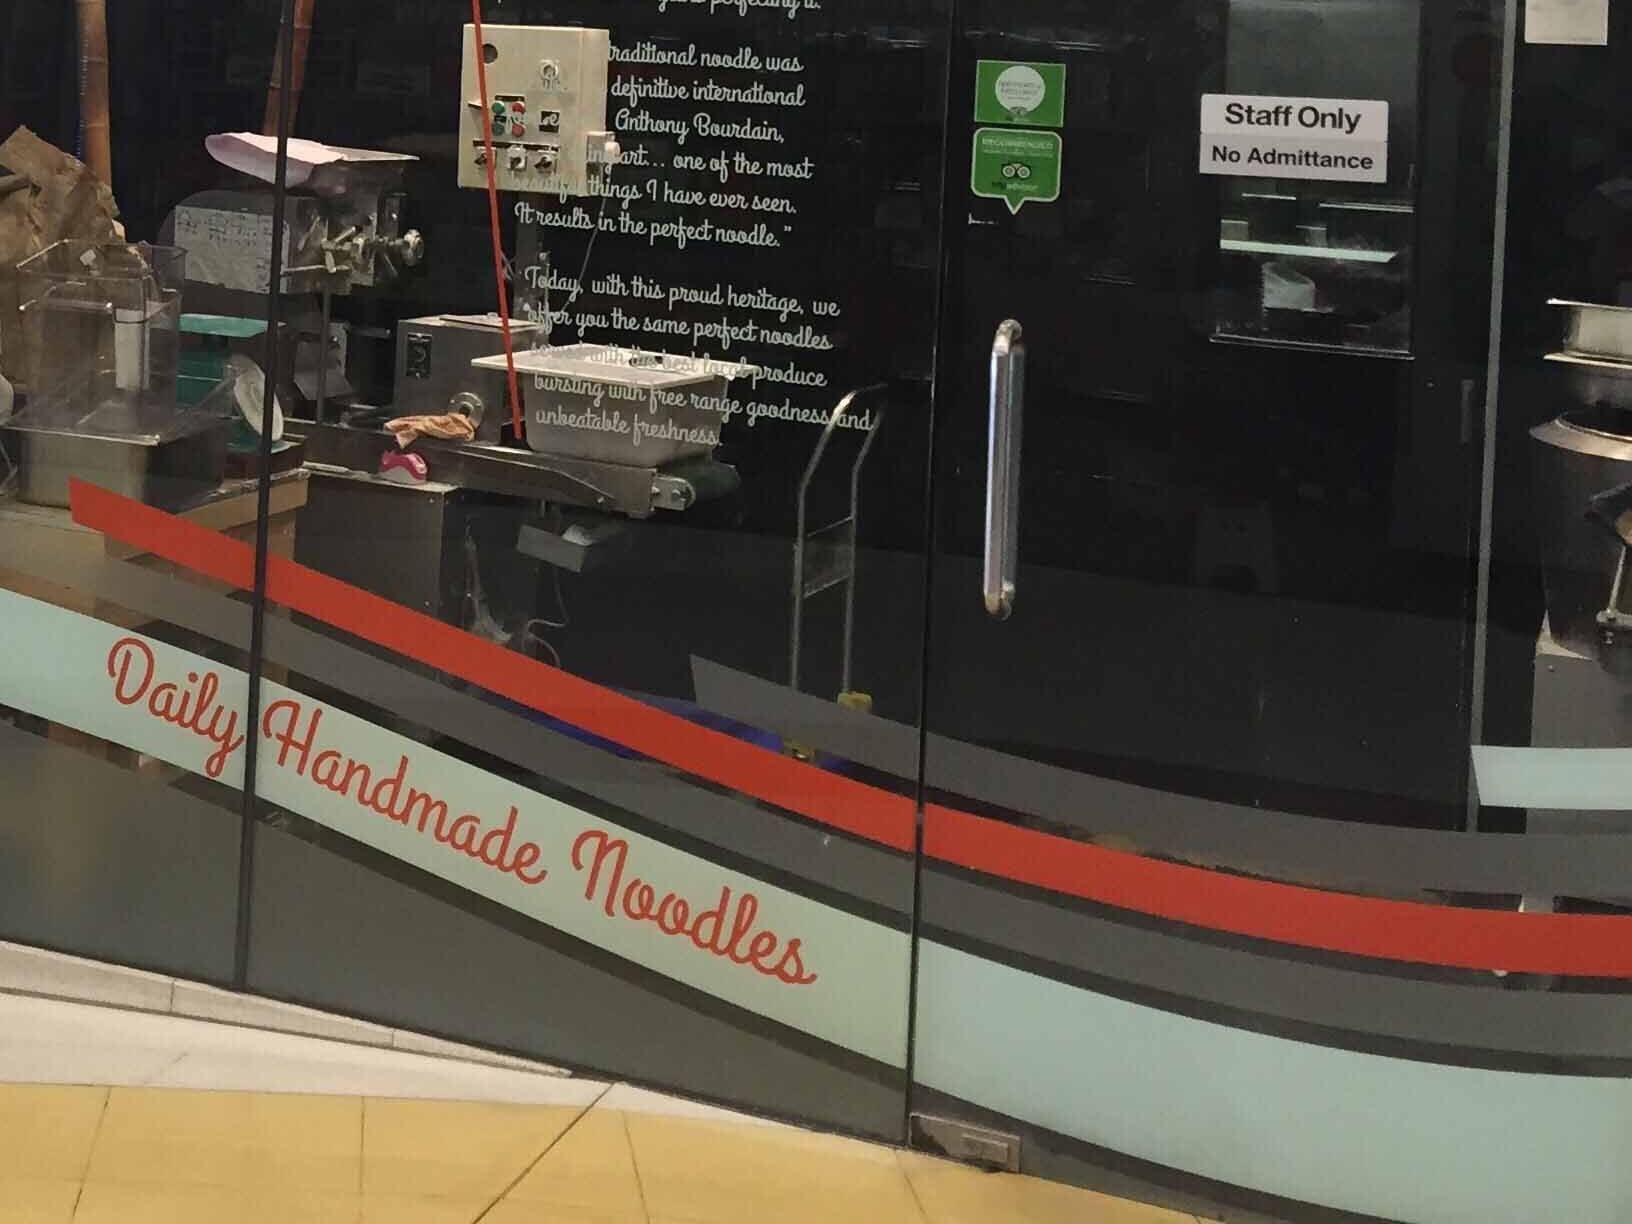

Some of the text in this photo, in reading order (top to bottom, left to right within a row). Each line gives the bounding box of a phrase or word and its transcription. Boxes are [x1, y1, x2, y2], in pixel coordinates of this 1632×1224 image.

[608, 40, 804, 73] traditional noodle was
[611, 75, 806, 107] definitive international
[615, 108, 785, 145] Anthony Bourdain,
[1225, 103, 1361, 134] Staff Only
[673, 154, 706, 171] one
[709, 151, 728, 183] of
[733, 152, 763, 174] the
[767, 160, 814, 179] most
[1212, 145, 1374, 170] No Admittance
[589, 177, 642, 209] things
[647, 179, 658, 201] I
[663, 181, 706, 206] have
[710, 191, 748, 209] ever
[752, 193, 797, 214] seen.
[514, 202, 536, 223] It
[536, 206, 596, 231] results
[598, 211, 616, 233] in
[618, 212, 647, 234] the
[650, 217, 713, 249] perfect
[524, 266, 583, 302] Today,
[592, 274, 629, 296] with
[631, 275, 665, 299] this
[669, 284, 724, 312] proud
[812, 299, 840, 317] we
[527, 302, 834, 350] offer you the same perfect noodles
[752, 362, 828, 390] produce
[534, 373, 603, 407] bursting
[650, 387, 687, 414] free
[691, 392, 742, 423] range
[746, 398, 833, 426] goodness
[836, 408, 874, 431] and
[536, 406, 723, 446] unbeatable freshness.
[107, 636, 817, 987] Daily Handmade Noodles
